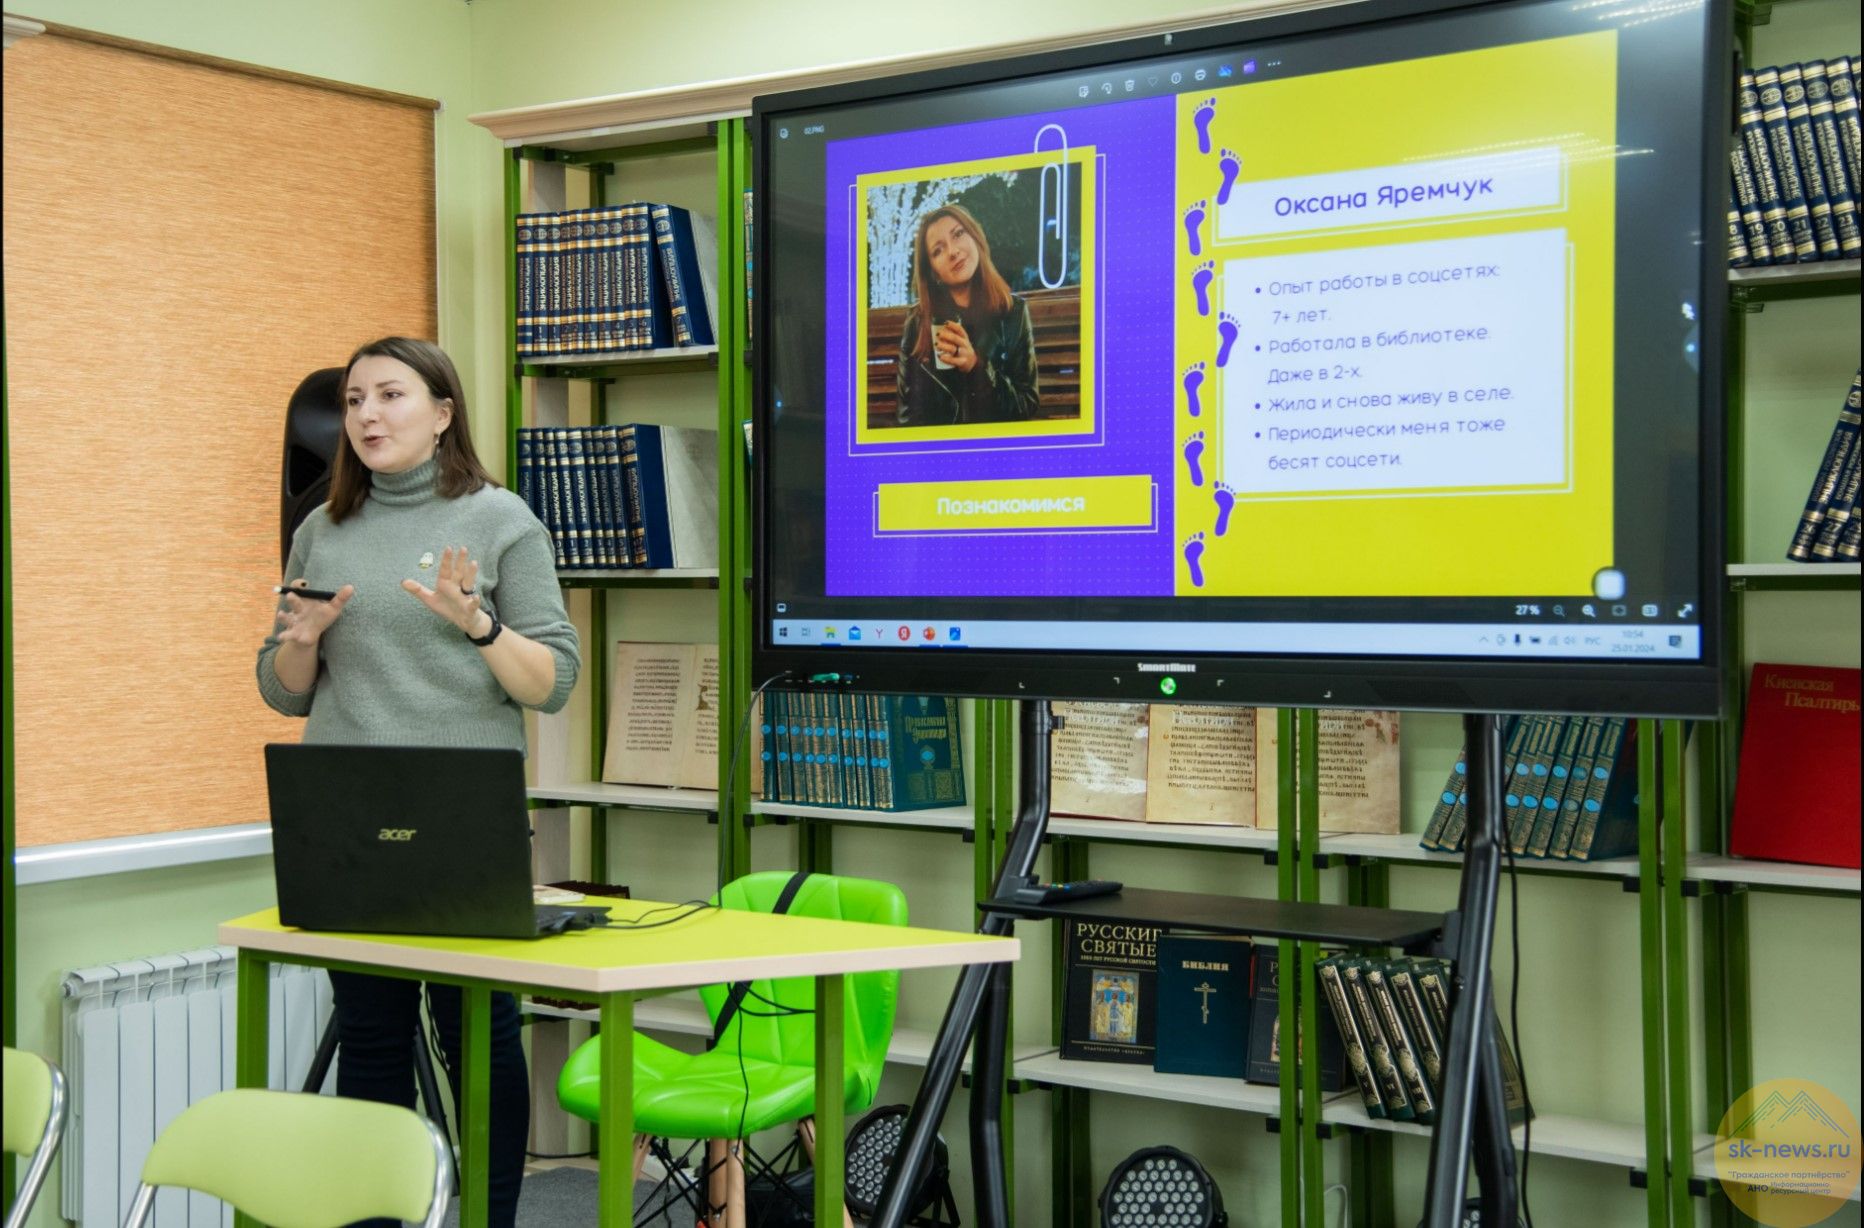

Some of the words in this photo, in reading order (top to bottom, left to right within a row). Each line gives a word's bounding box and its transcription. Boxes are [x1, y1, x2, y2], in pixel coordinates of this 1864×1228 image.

[1274, 191, 1367, 216] Оксана
[1377, 178, 1494, 208] Яремчук
[1749, 223, 1764, 235] 19
[1771, 221, 1785, 234] 20
[1794, 220, 1806, 232] 21
[1269, 281, 1313, 296] Опыт
[1320, 274, 1387, 295] работы
[1393, 273, 1402, 285] в
[1408, 264, 1500, 284] соцсетях:
[1272, 311, 1290, 324] 7+
[1296, 309, 1331, 323] лет.
[1269, 336, 1356, 354] Работала
[1362, 335, 1371, 348] в
[1268, 367, 1313, 384] Даже
[1319, 367, 1328, 380] в
[1268, 398, 1316, 412] Жила
[1322, 397, 1331, 409] и
[1337, 394, 1392, 409] снова
[1397, 390, 1443, 407] живу
[1448, 390, 1457, 403] в
[1464, 385, 1515, 402] селе.
[1268, 423, 1395, 444] Периодически
[1401, 421, 1450, 435] меня
[1457, 417, 1506, 433] тоже
[1268, 454, 1319, 471] бесят
[1325, 450, 1402, 468] соцсети.
[936, 495, 1086, 516] Познакомимся
[1764, 673, 1835, 693] Киевская
[1784, 693, 1860, 714] Псалтирь
[378, 828, 417, 842] acer
[1081, 939, 1156, 957] СВЯТЫЕ
[1181, 960, 1229, 972] БИБЛИЯ
